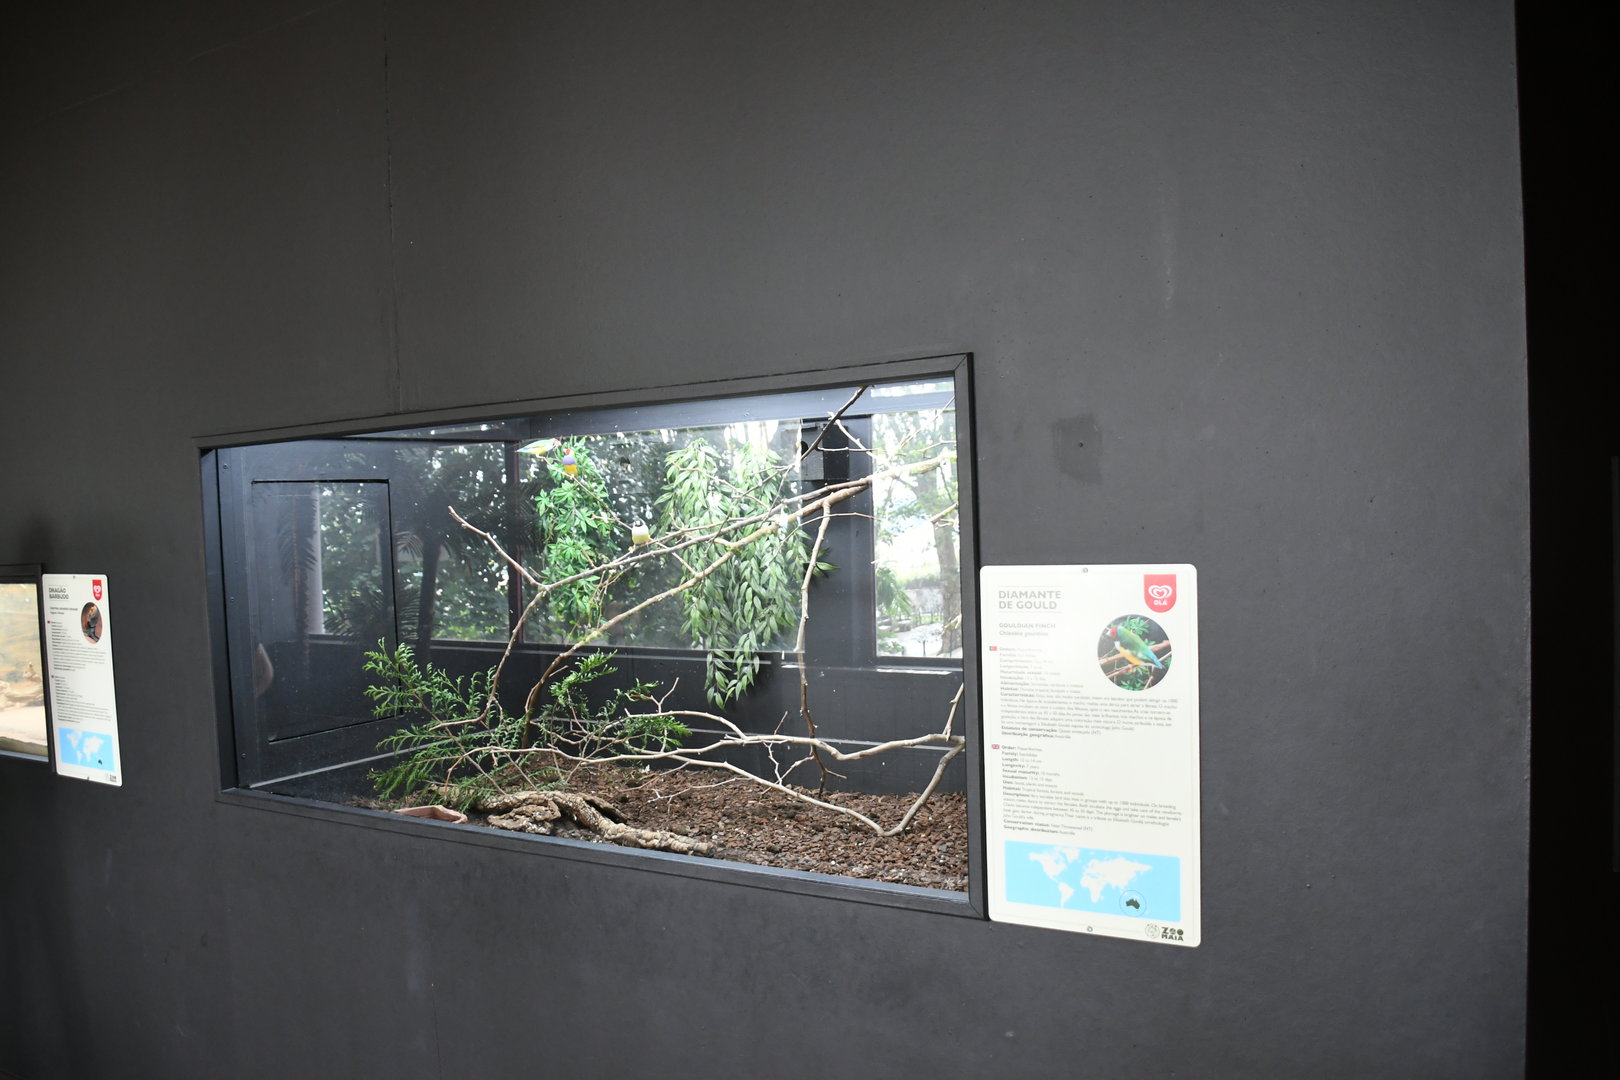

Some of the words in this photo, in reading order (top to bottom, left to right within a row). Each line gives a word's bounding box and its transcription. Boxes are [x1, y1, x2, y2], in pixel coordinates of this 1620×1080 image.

[998, 590, 1062, 599] DIAMANTE
[998, 600, 1013, 610] DE
[1016, 600, 1057, 610] GOULD
